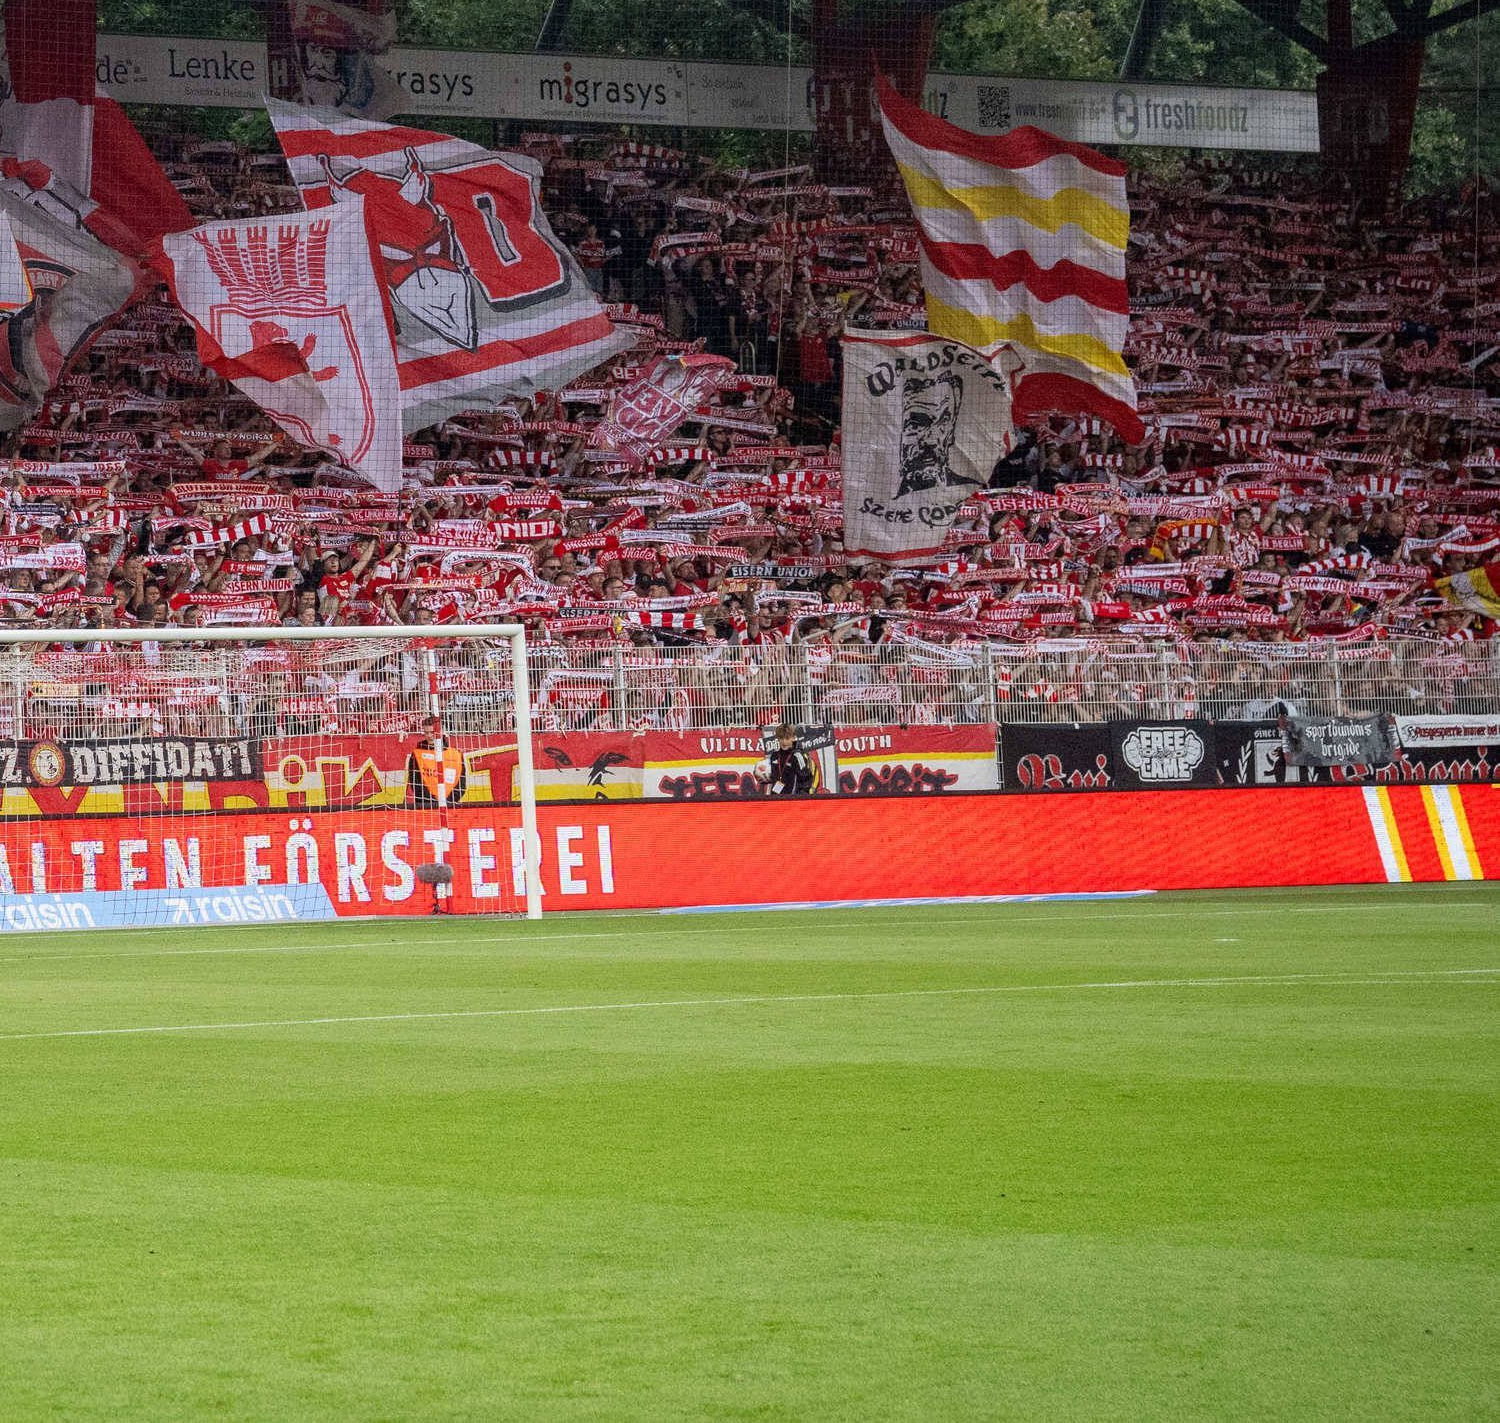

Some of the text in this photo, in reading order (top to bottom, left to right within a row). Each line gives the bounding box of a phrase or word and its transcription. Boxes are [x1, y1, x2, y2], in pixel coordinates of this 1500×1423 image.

[168, 47, 256, 84] Lenke
[539, 60, 668, 112] migrasys
[1269, 536, 1304, 551] BERLIN
[731, 565, 817, 578] EISERN UNION
[71, 739, 250, 785] DIFFIDATI
[243, 817, 616, 905] FÖRSTEREI
[196, 883, 297, 920] raisin
